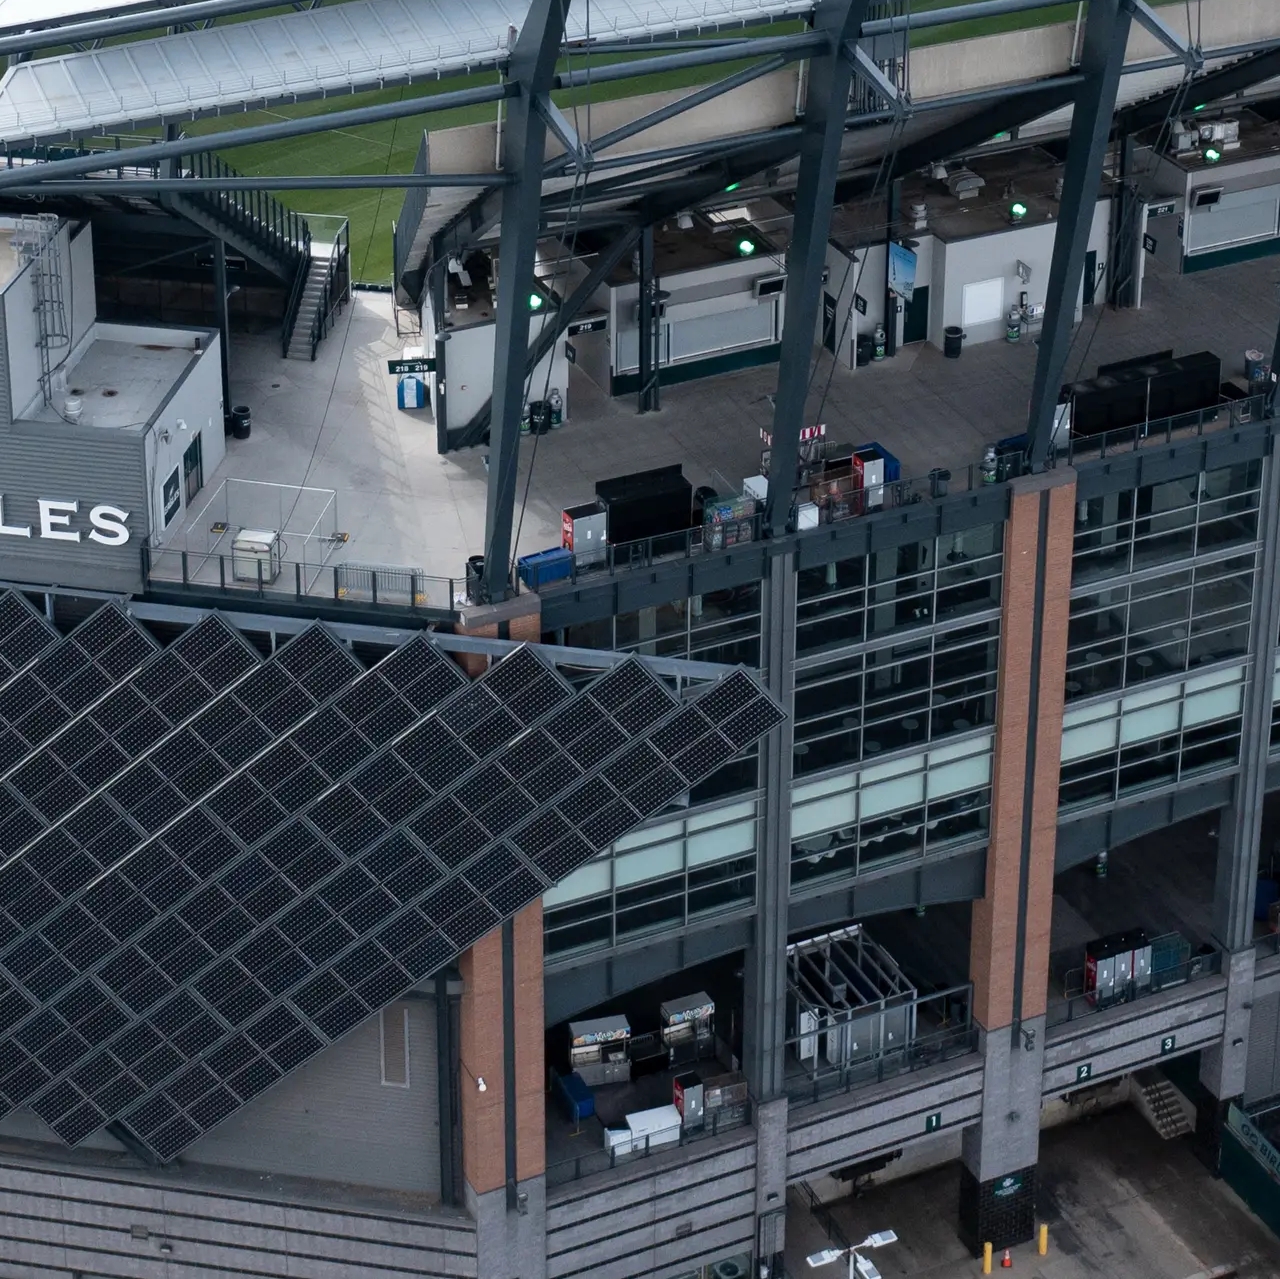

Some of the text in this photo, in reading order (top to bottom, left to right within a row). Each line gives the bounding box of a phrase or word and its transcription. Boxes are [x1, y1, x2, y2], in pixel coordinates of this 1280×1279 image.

[579, 323, 592, 331] 219
[396, 365, 409, 373] 218
[1164, 1038, 1173, 1050] 3
[1080, 1066, 1089, 1078] 2
[931, 1115, 937, 1127] 1
[1240, 1123, 1259, 1147] GO
